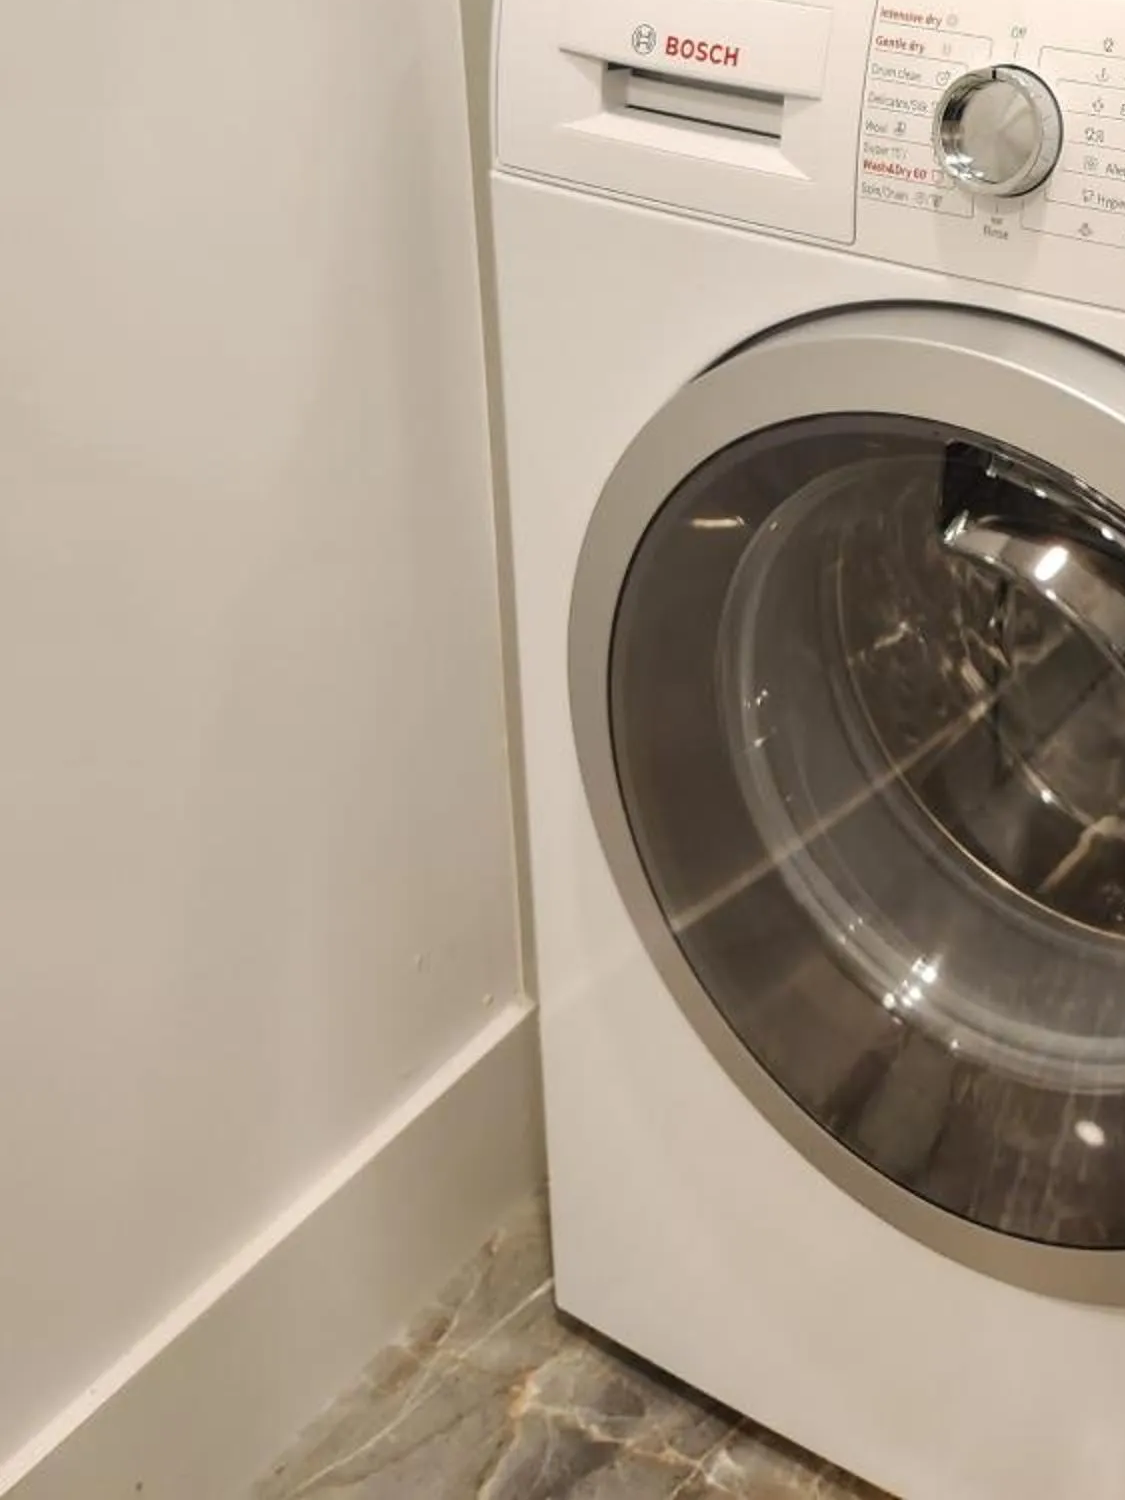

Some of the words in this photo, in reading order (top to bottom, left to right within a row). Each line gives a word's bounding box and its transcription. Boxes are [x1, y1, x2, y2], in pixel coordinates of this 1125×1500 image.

[925, 12, 943, 29] dry
[664, 35, 740, 67] BOSCH
[875, 35, 907, 50] Gentle
[909, 40, 926, 54] dry
